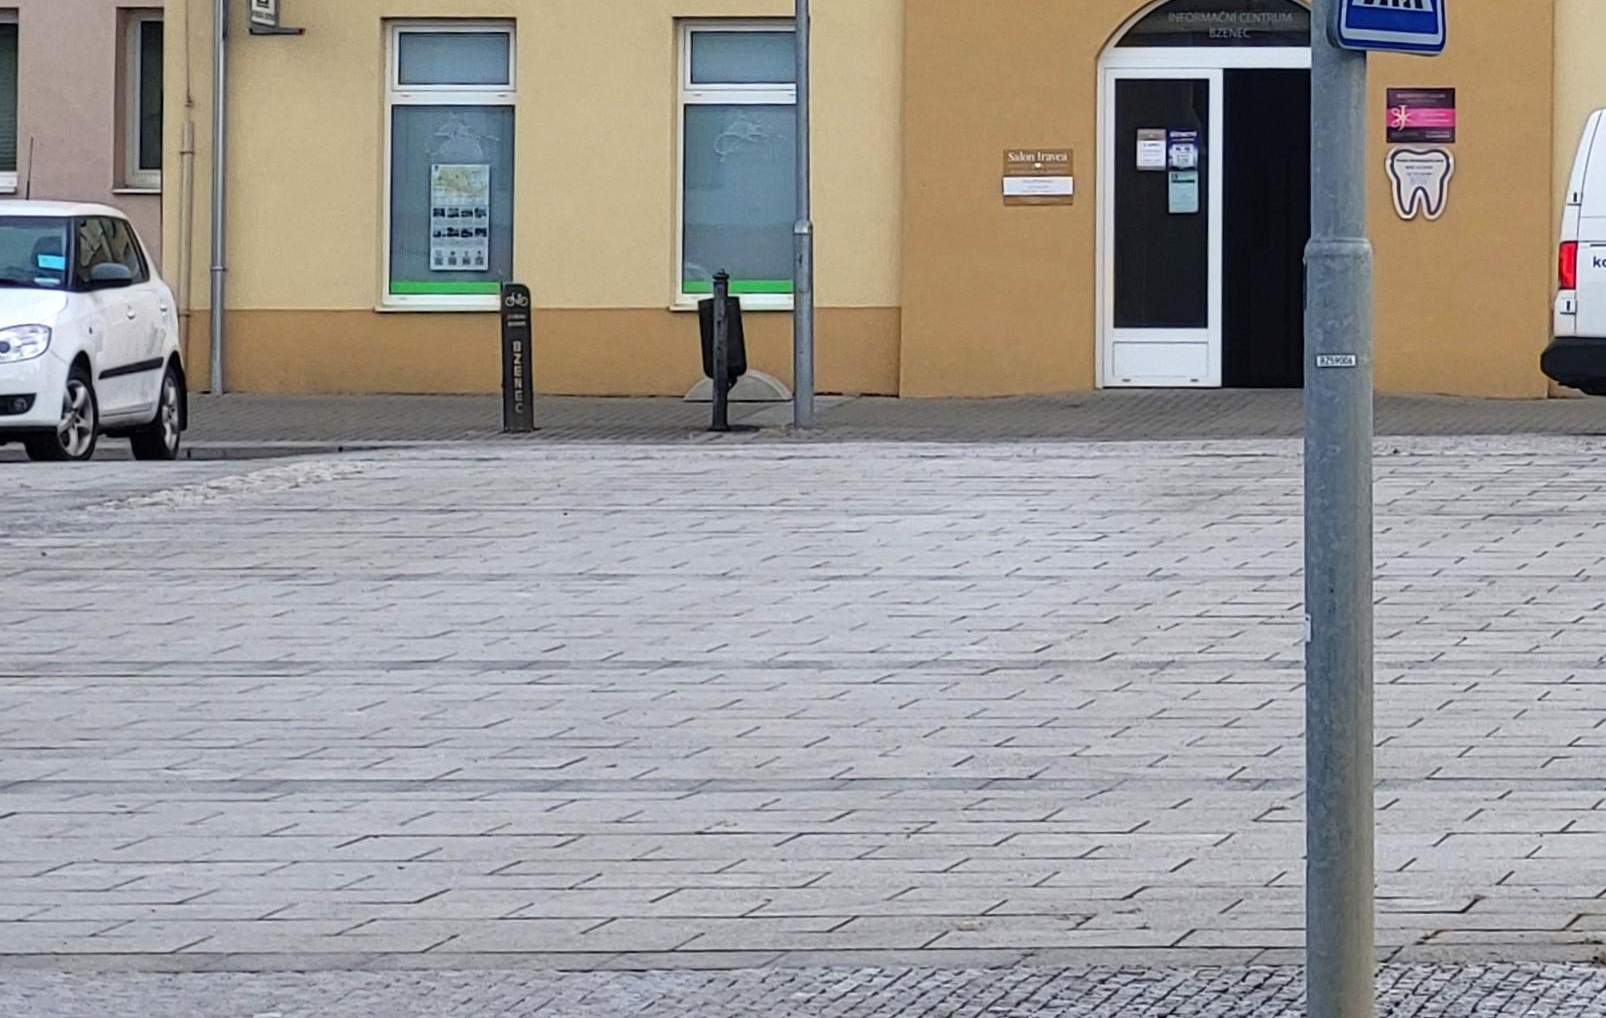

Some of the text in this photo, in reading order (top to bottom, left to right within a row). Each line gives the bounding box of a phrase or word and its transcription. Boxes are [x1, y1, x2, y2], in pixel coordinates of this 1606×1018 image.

[1167, 10, 1294, 23] INFORMAČNÍ CENTRUM
[1208, 27, 1251, 39] BZENEC
[512, 340, 524, 414] BZENEC
